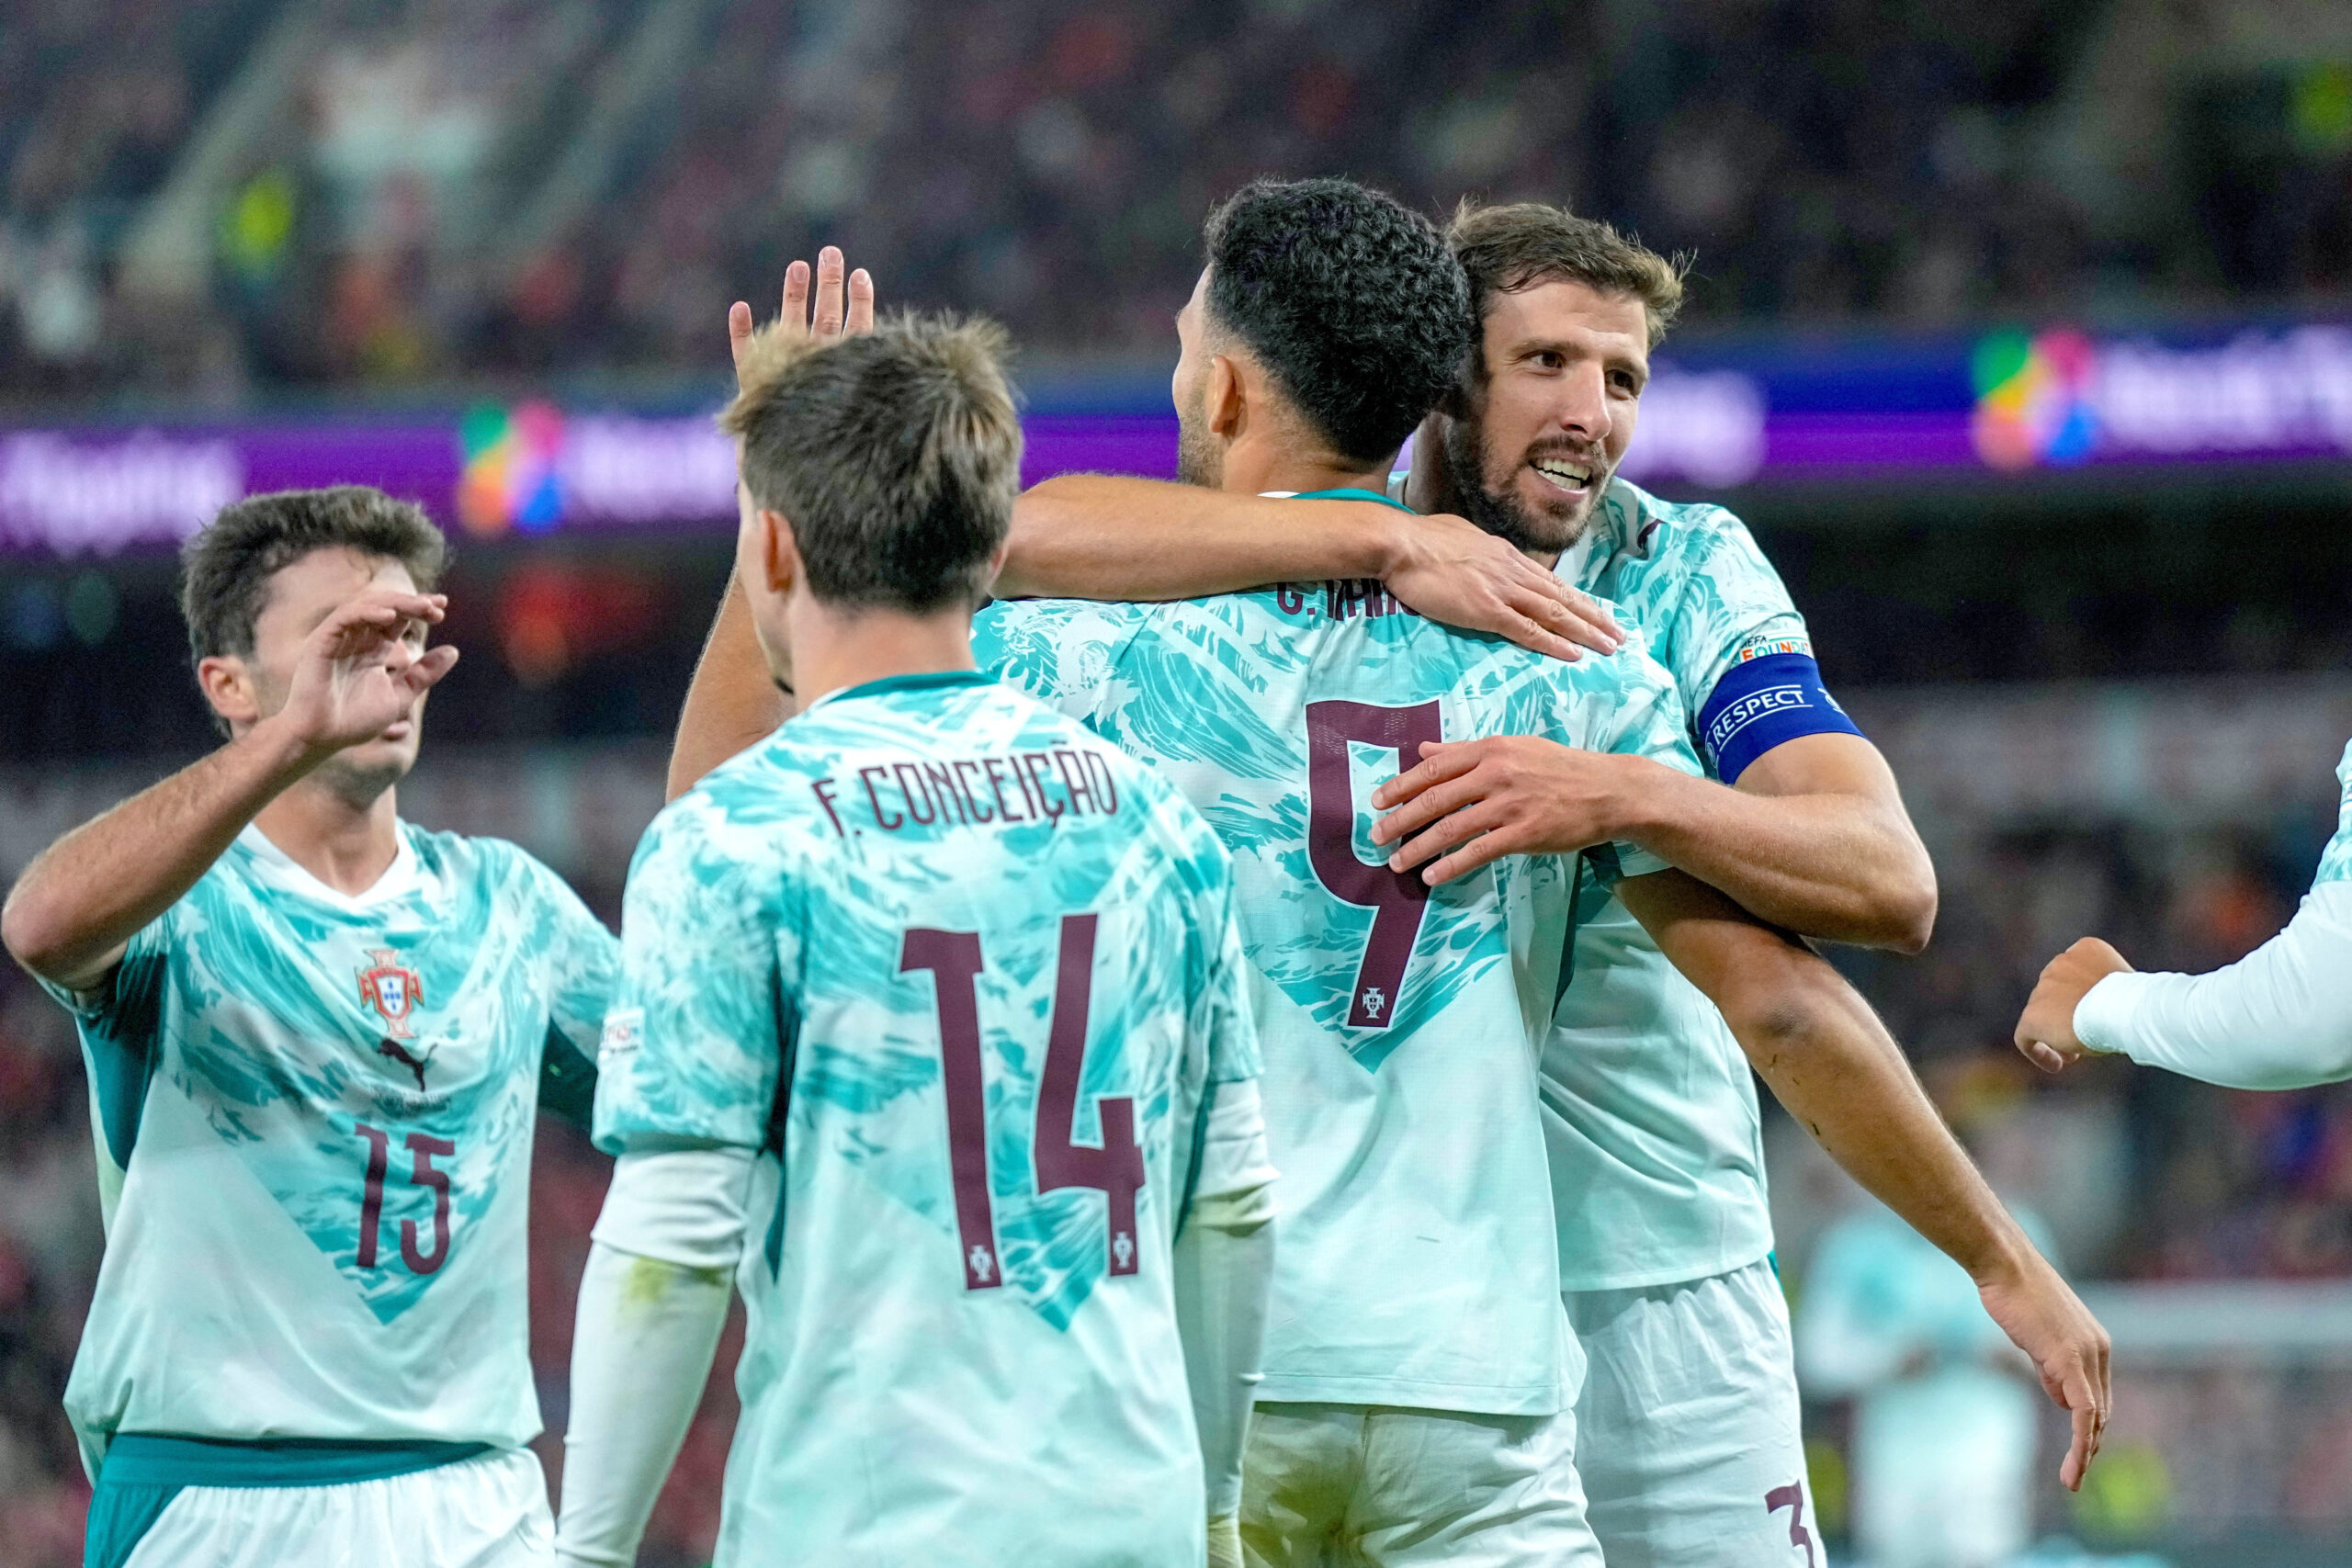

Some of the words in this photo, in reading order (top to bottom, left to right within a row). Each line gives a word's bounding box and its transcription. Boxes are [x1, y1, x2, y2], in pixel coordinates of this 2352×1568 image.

[1277, 581, 1316, 615] G.
[1713, 691, 1804, 745] RESPECT
[811, 779, 862, 837] F.
[859, 740, 1117, 830] CONCEIÇÃO
[1306, 700, 1441, 1027] 9
[900, 914, 1145, 1290] 14
[355, 1122, 455, 1275] 15
